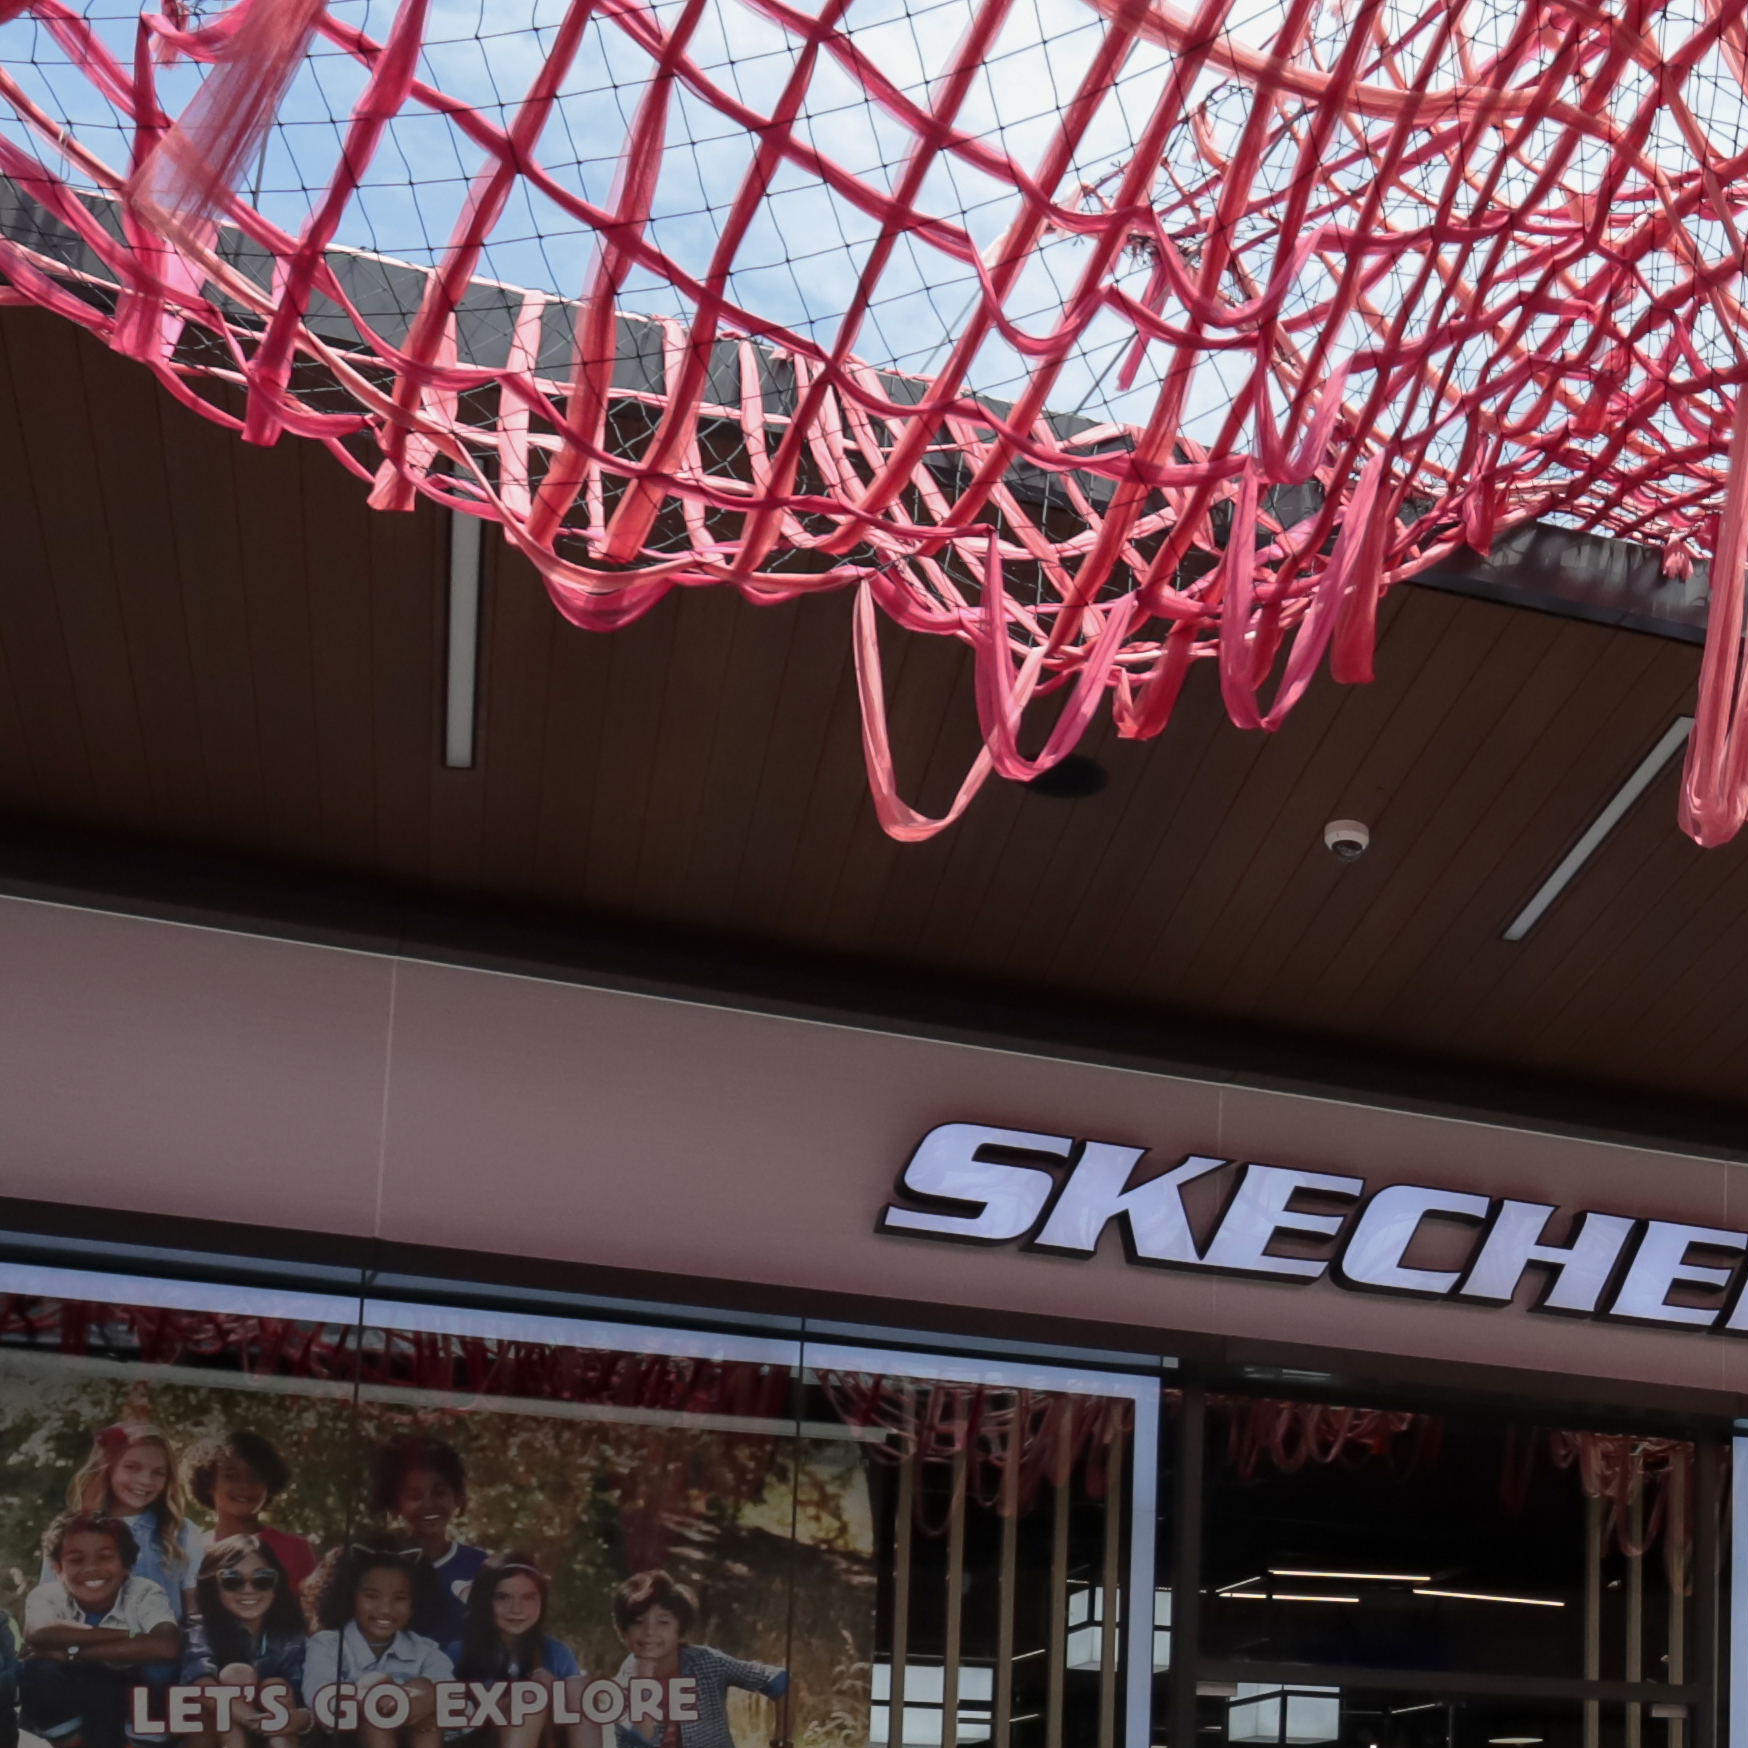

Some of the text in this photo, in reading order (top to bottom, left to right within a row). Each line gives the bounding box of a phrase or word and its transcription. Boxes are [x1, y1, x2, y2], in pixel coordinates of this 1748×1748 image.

[132, 1677, 700, 1735] LET'S GO EXPLORE
